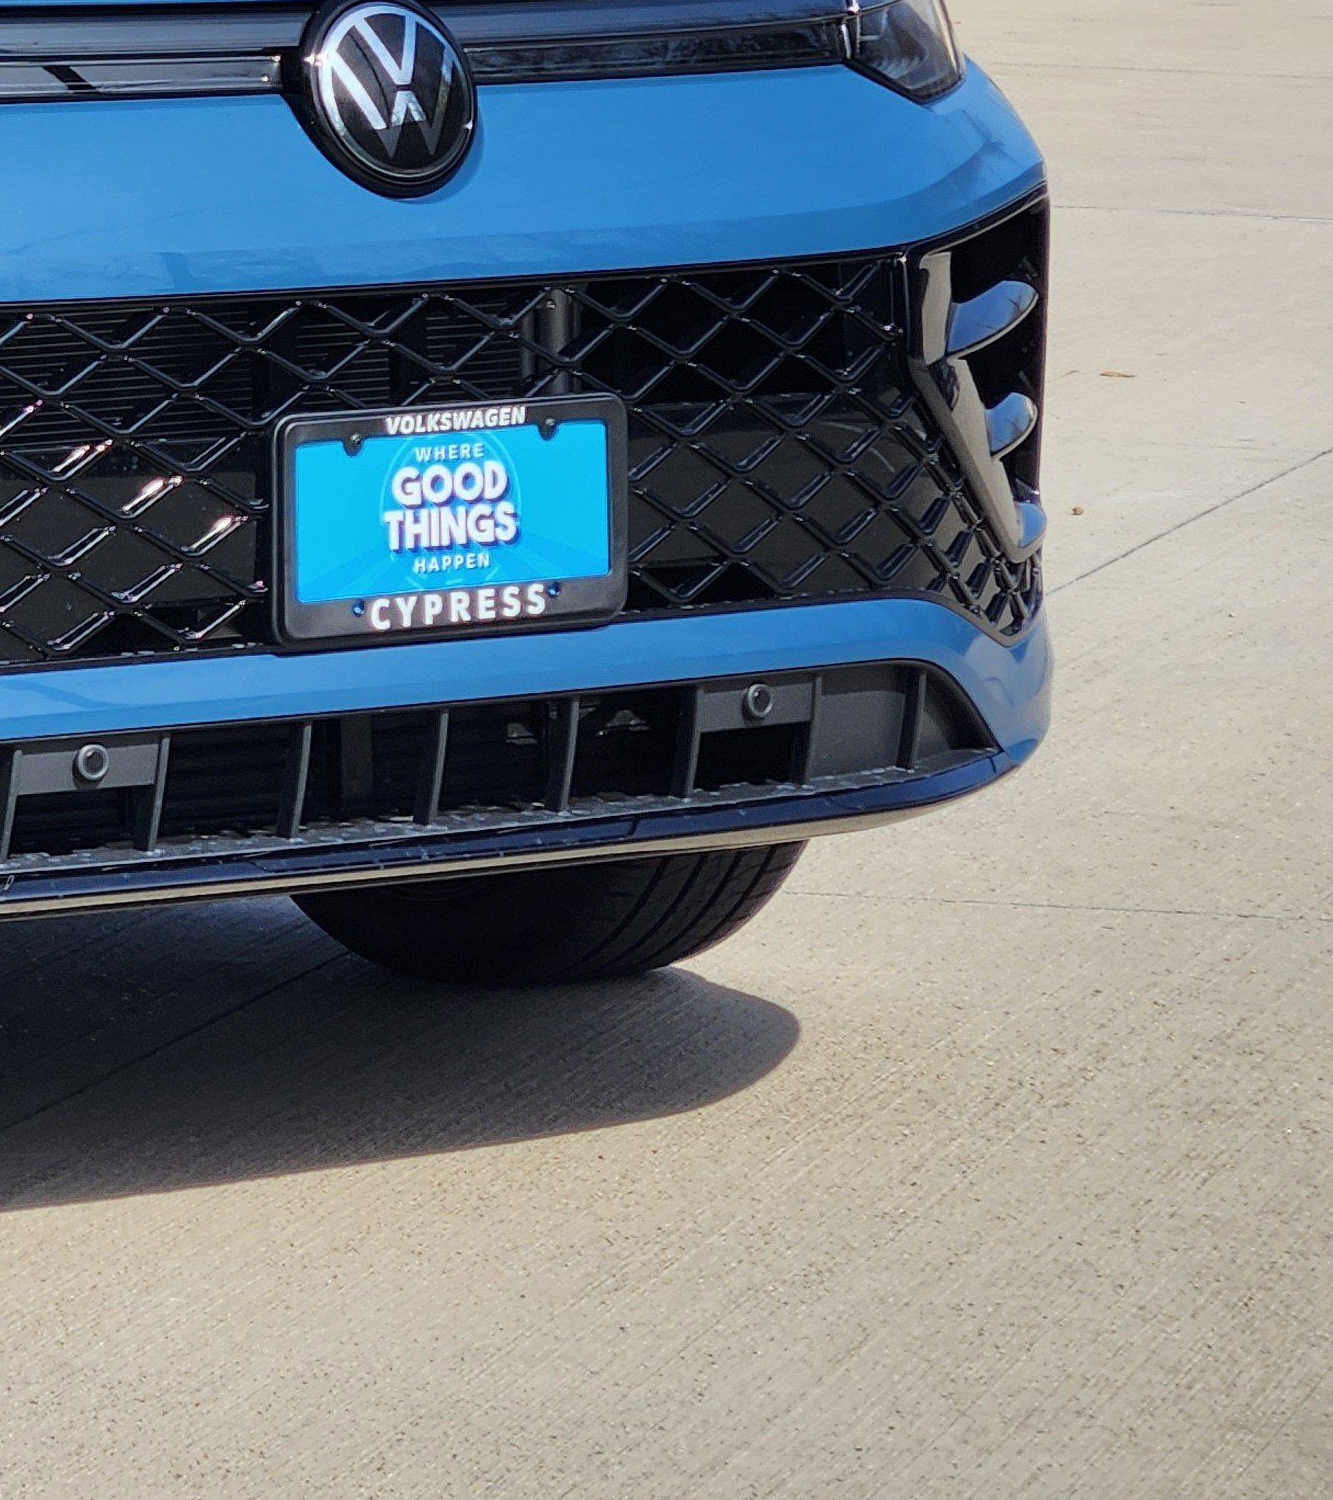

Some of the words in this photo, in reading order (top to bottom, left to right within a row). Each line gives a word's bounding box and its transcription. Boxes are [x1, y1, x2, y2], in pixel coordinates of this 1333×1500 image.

[320, 2, 469, 172] VW
[385, 406, 526, 436] VOLKSWAGEN
[415, 443, 485, 461] WHERE
[391, 461, 509, 507] GOOD
[383, 501, 519, 553] THINGS
[413, 553, 491, 574] HAPPEN
[369, 583, 547, 631] CYPRESS
